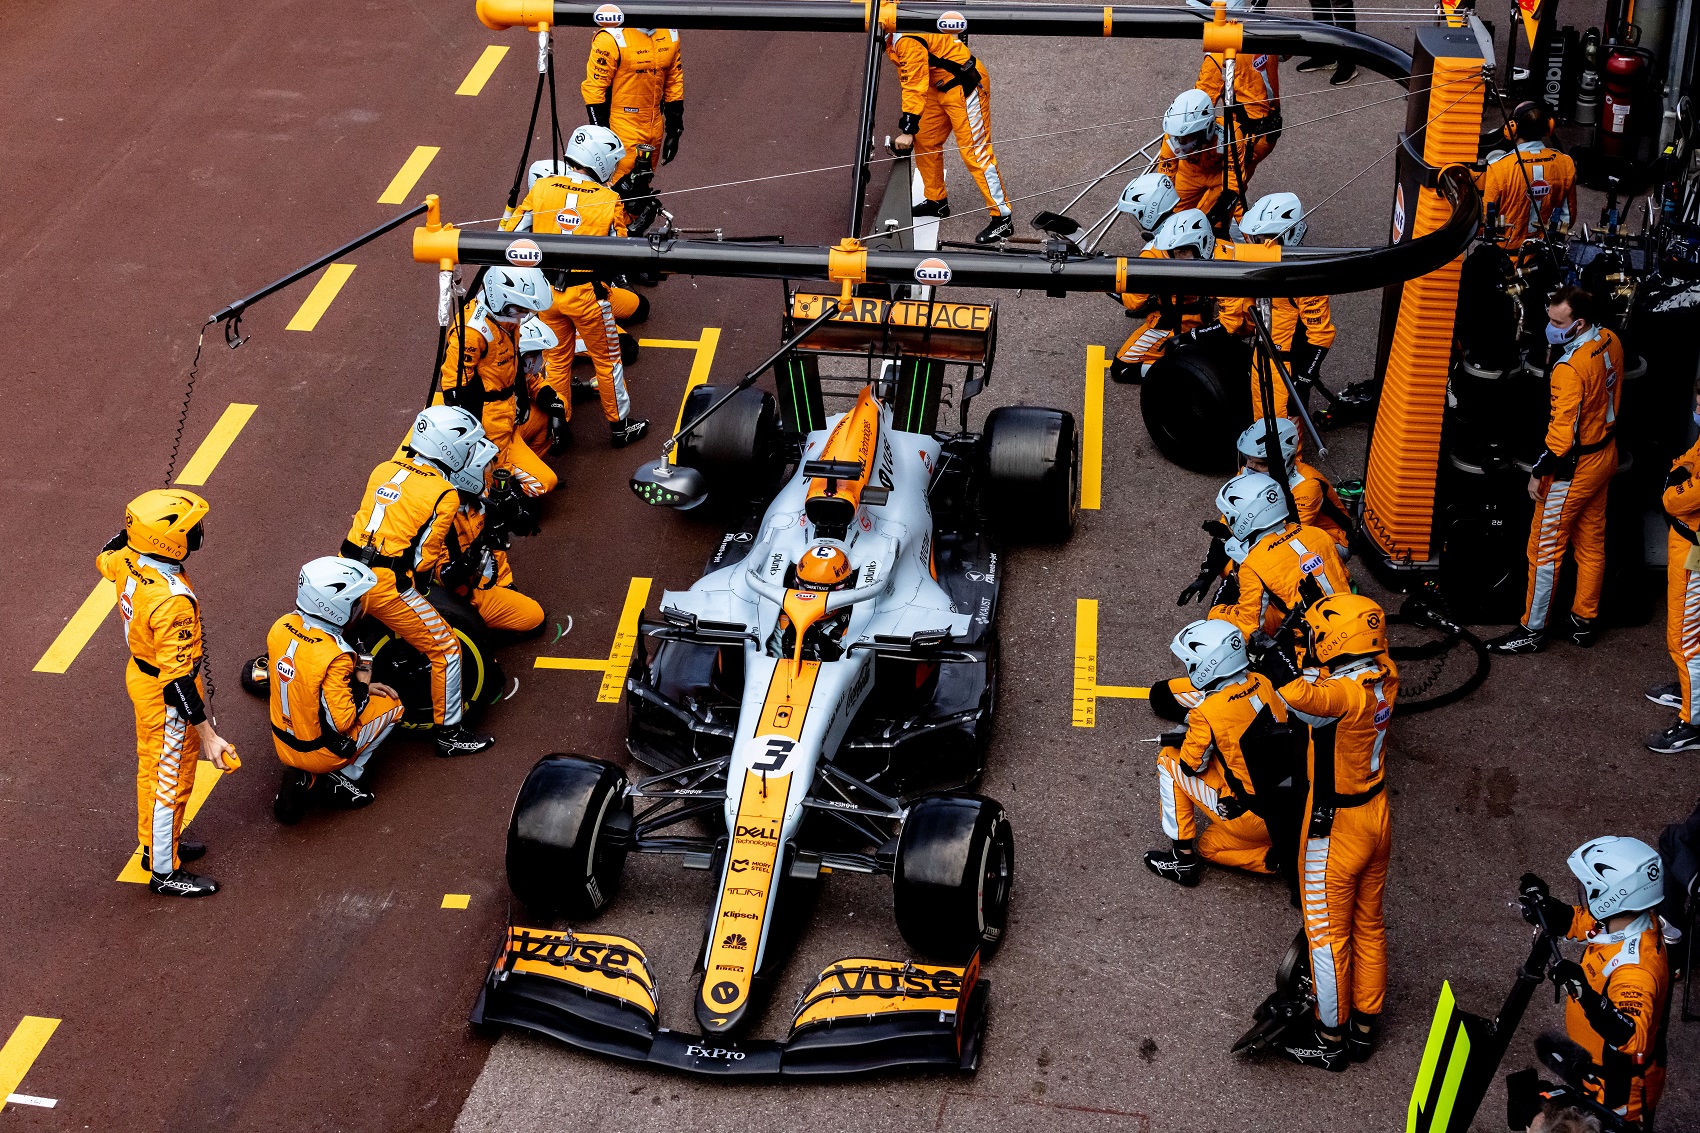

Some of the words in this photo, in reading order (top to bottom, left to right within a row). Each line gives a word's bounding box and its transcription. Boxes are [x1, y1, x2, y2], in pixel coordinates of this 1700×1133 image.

[595, 13, 623, 23] Gulf
[938, 20, 967, 30] Gulf
[1253, 53, 1269, 70] Gulf
[551, 182, 595, 194] McLaren
[557, 214, 580, 225] Gulf
[507, 249, 541, 261] Gulf
[916, 268, 951, 280] Gulf
[439, 441, 460, 468] IQONIQ
[391, 460, 429, 477] McLaren
[376, 487, 400, 500] Gulf
[1237, 512, 1255, 536] IQONIQ
[148, 535, 182, 558] IQONIQ
[1267, 525, 1303, 552] McLaren
[1302, 556, 1322, 573] Gulf
[315, 597, 343, 623] IQONIQ
[283, 622, 315, 644] McLaren
[1319, 631, 1348, 659] IQONIQ
[277, 661, 295, 678] Gulf
[1195, 658, 1218, 686] IQONIQ
[1227, 681, 1261, 703] McLaren
[1374, 708, 1391, 724] Gulf
[453, 741, 479, 750] sparco
[751, 739, 796, 772] 3
[735, 824, 778, 841] DELL
[735, 837, 778, 848] Technologies
[750, 866, 771, 874] STEEL
[1594, 888, 1628, 916] IQONIQ
[722, 910, 760, 921] Klipsch
[518, 930, 630, 980] vuse
[721, 943, 748, 951] CNBC
[715, 964, 745, 973] PIRELLI
[833, 963, 960, 1000] vuse
[684, 1044, 747, 1062] FxPro
[1293, 1047, 1323, 1058] sparco
